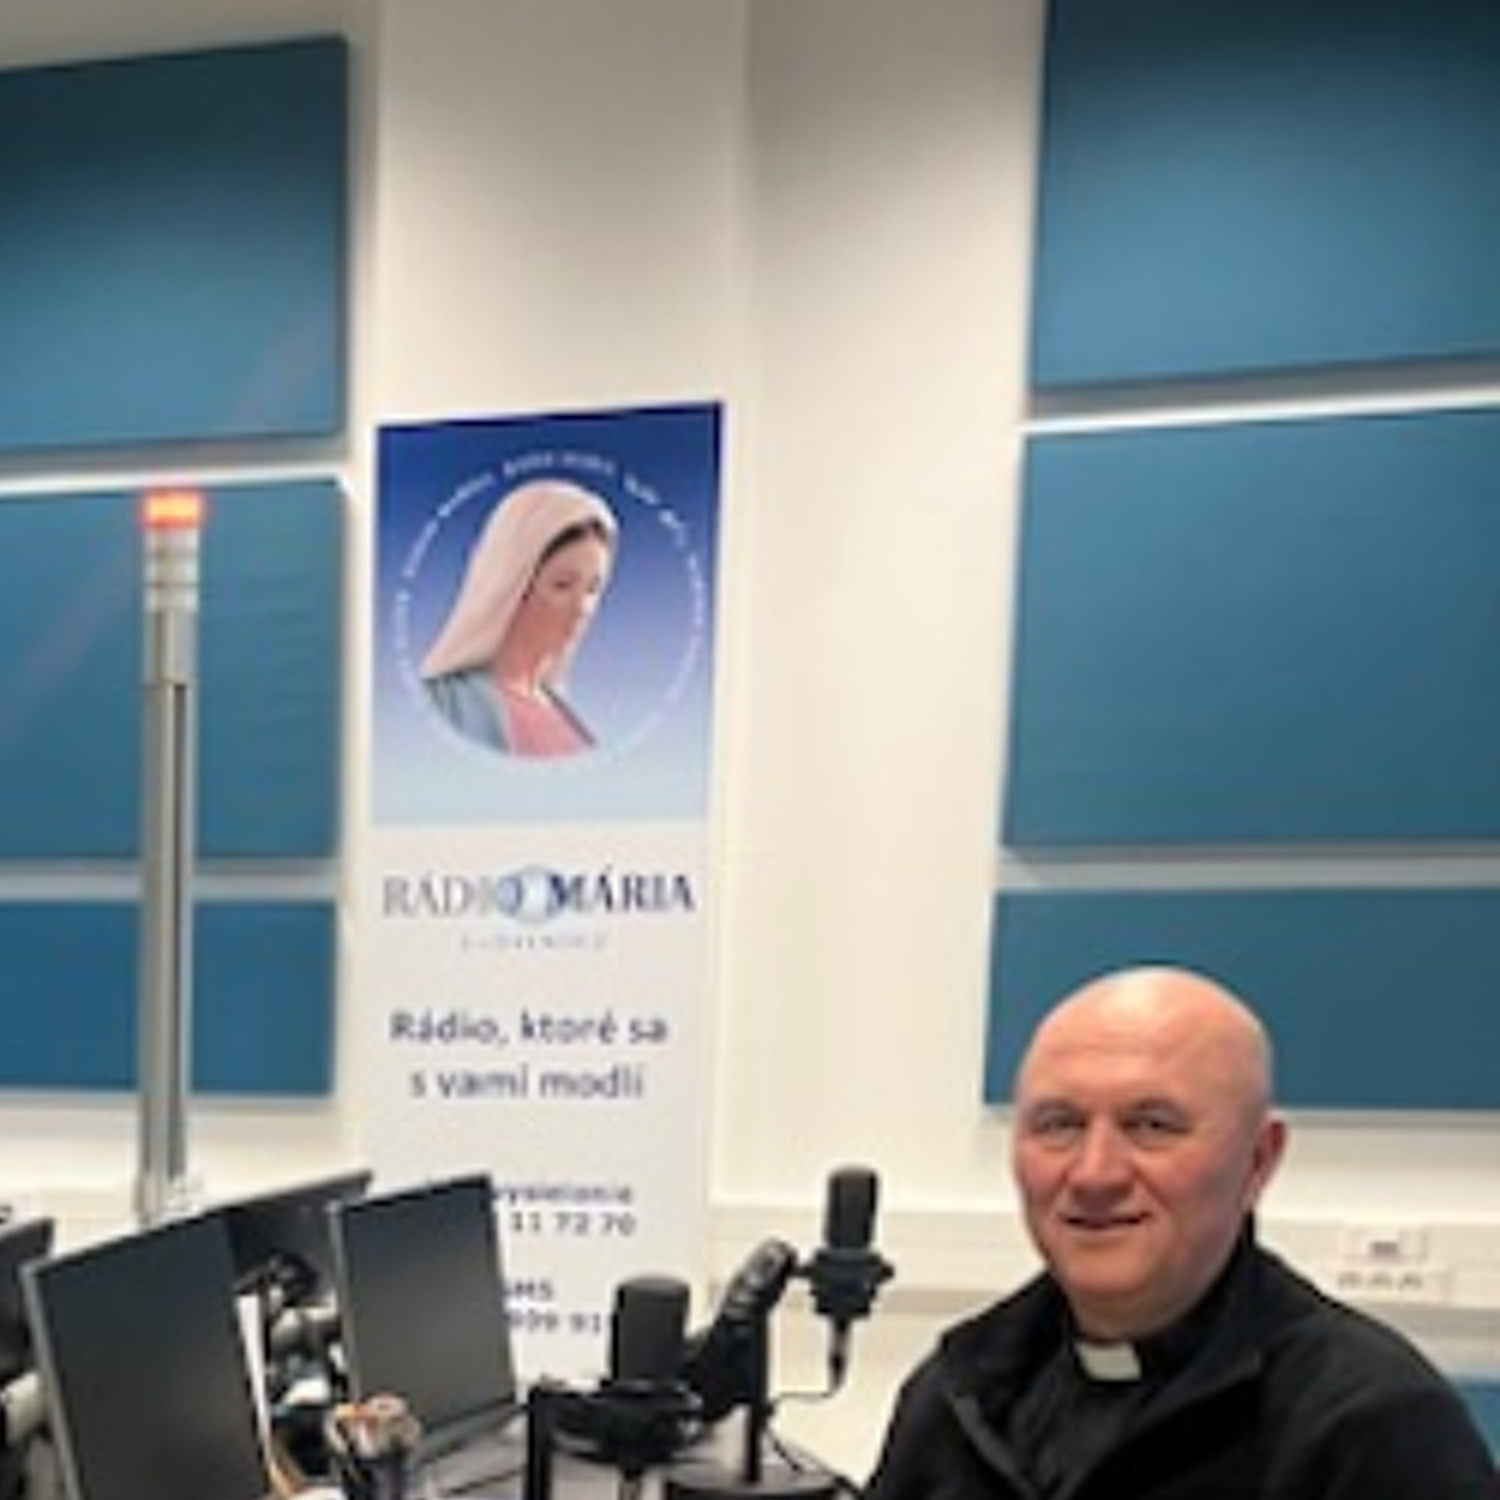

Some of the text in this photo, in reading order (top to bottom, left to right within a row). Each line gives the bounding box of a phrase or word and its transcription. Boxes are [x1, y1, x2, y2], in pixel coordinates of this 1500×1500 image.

[546, 864, 696, 914] MÁRIA
[389, 1007, 669, 1047] Rádio, ktoré sa
[410, 1071, 426, 1098] s
